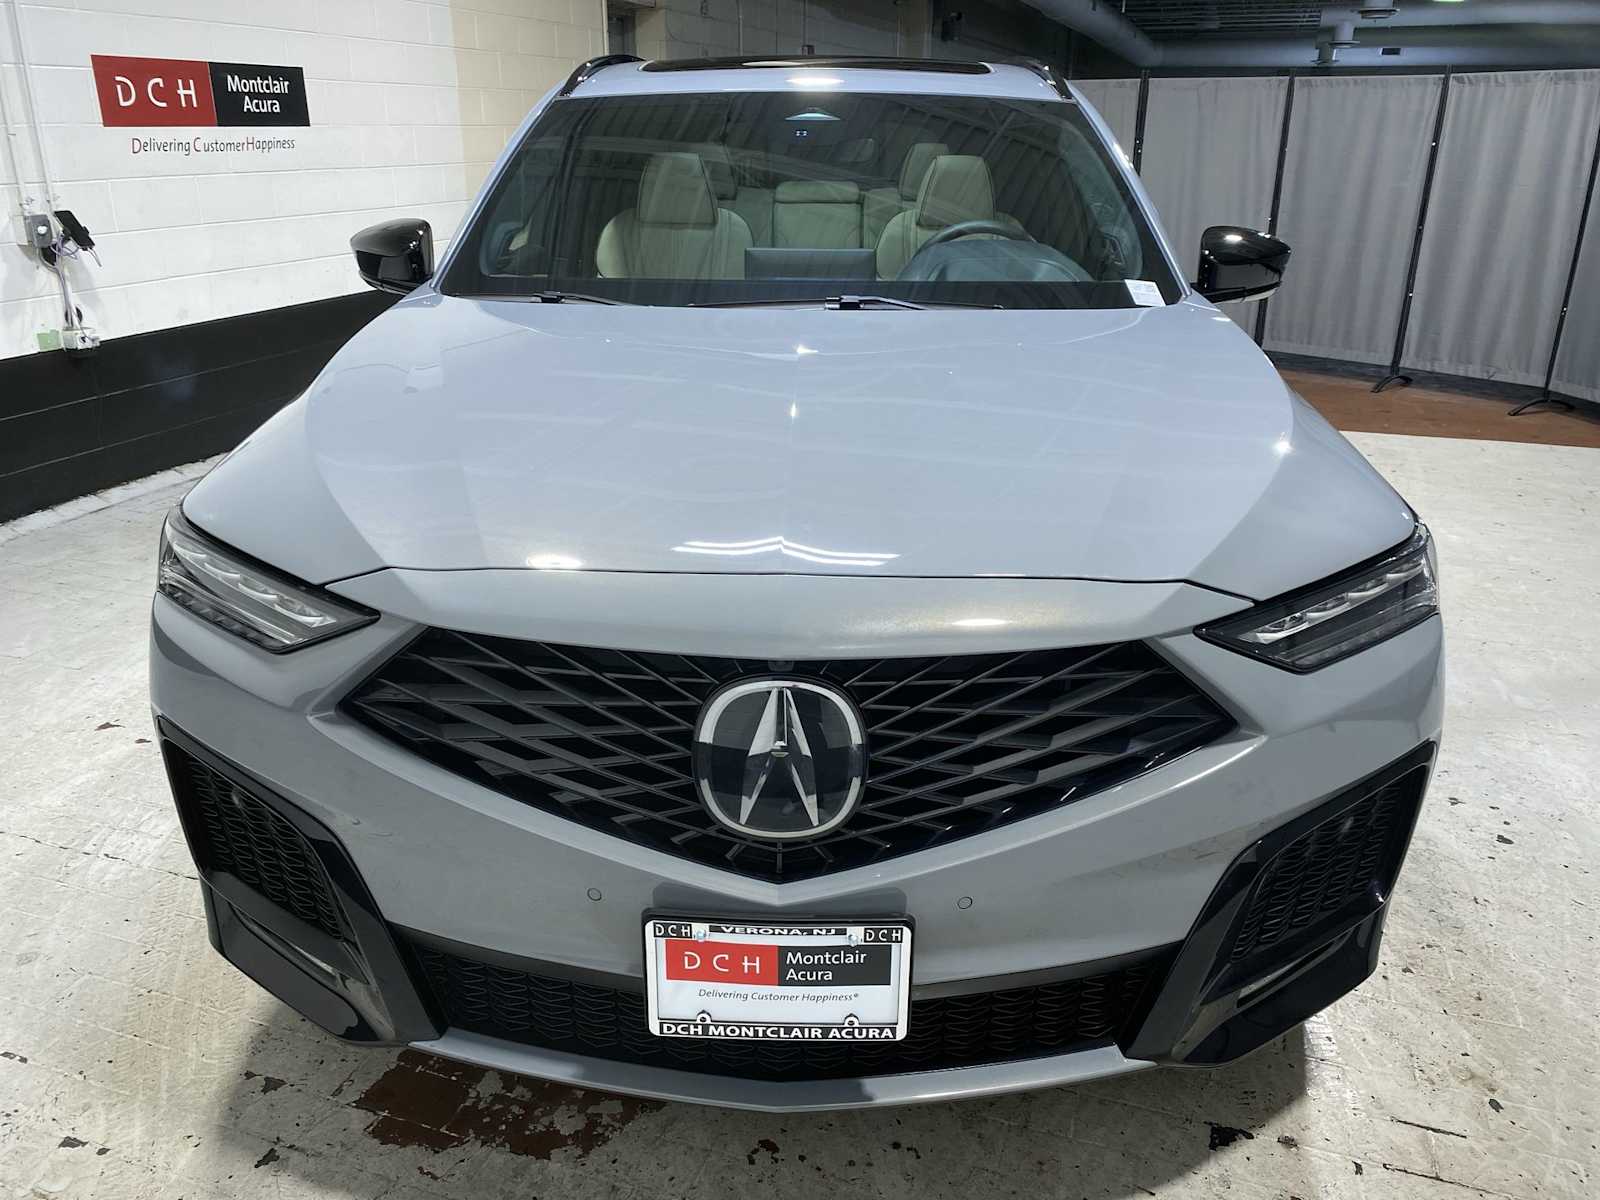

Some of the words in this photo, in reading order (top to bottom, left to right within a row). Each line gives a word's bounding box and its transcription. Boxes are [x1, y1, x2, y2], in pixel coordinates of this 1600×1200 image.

[114, 75, 198, 108] DCH
[226, 74, 290, 95] Montclair
[243, 96, 281, 113] Acura
[131, 137, 191, 156] Delivering
[655, 924, 692, 937] DCH
[720, 926, 809, 936] VERONA,
[813, 928, 836, 936] NJ
[865, 929, 902, 942] DCH
[684, 951, 760, 975] DCH
[786, 950, 867, 965] Montclair
[786, 968, 833, 981] Acura
[698, 988, 749, 1001] Delivering
[751, 991, 800, 1001] Customer
[662, 1022, 702, 1036] DCH
[707, 1025, 823, 1039] MONTCLAIR
[828, 1027, 894, 1040] ACURA
